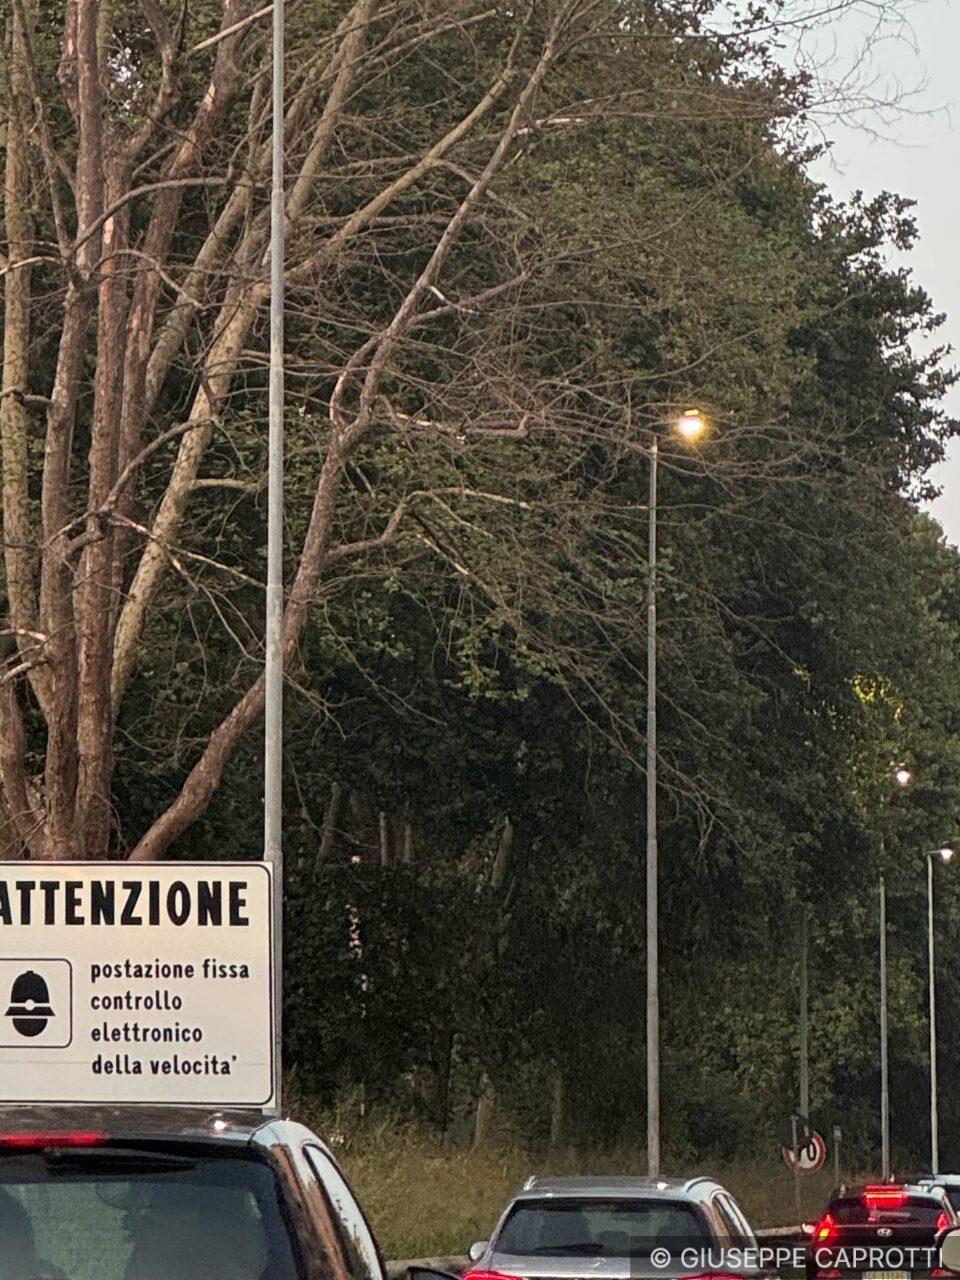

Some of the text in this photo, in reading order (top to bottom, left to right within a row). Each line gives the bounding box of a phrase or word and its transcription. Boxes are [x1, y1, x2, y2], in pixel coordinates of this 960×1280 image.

[90, 958, 250, 983] postazione fissa
[90, 989, 182, 1011] controllo
[90, 1021, 203, 1043] elettronico
[91, 1054, 237, 1075] della velocita'
